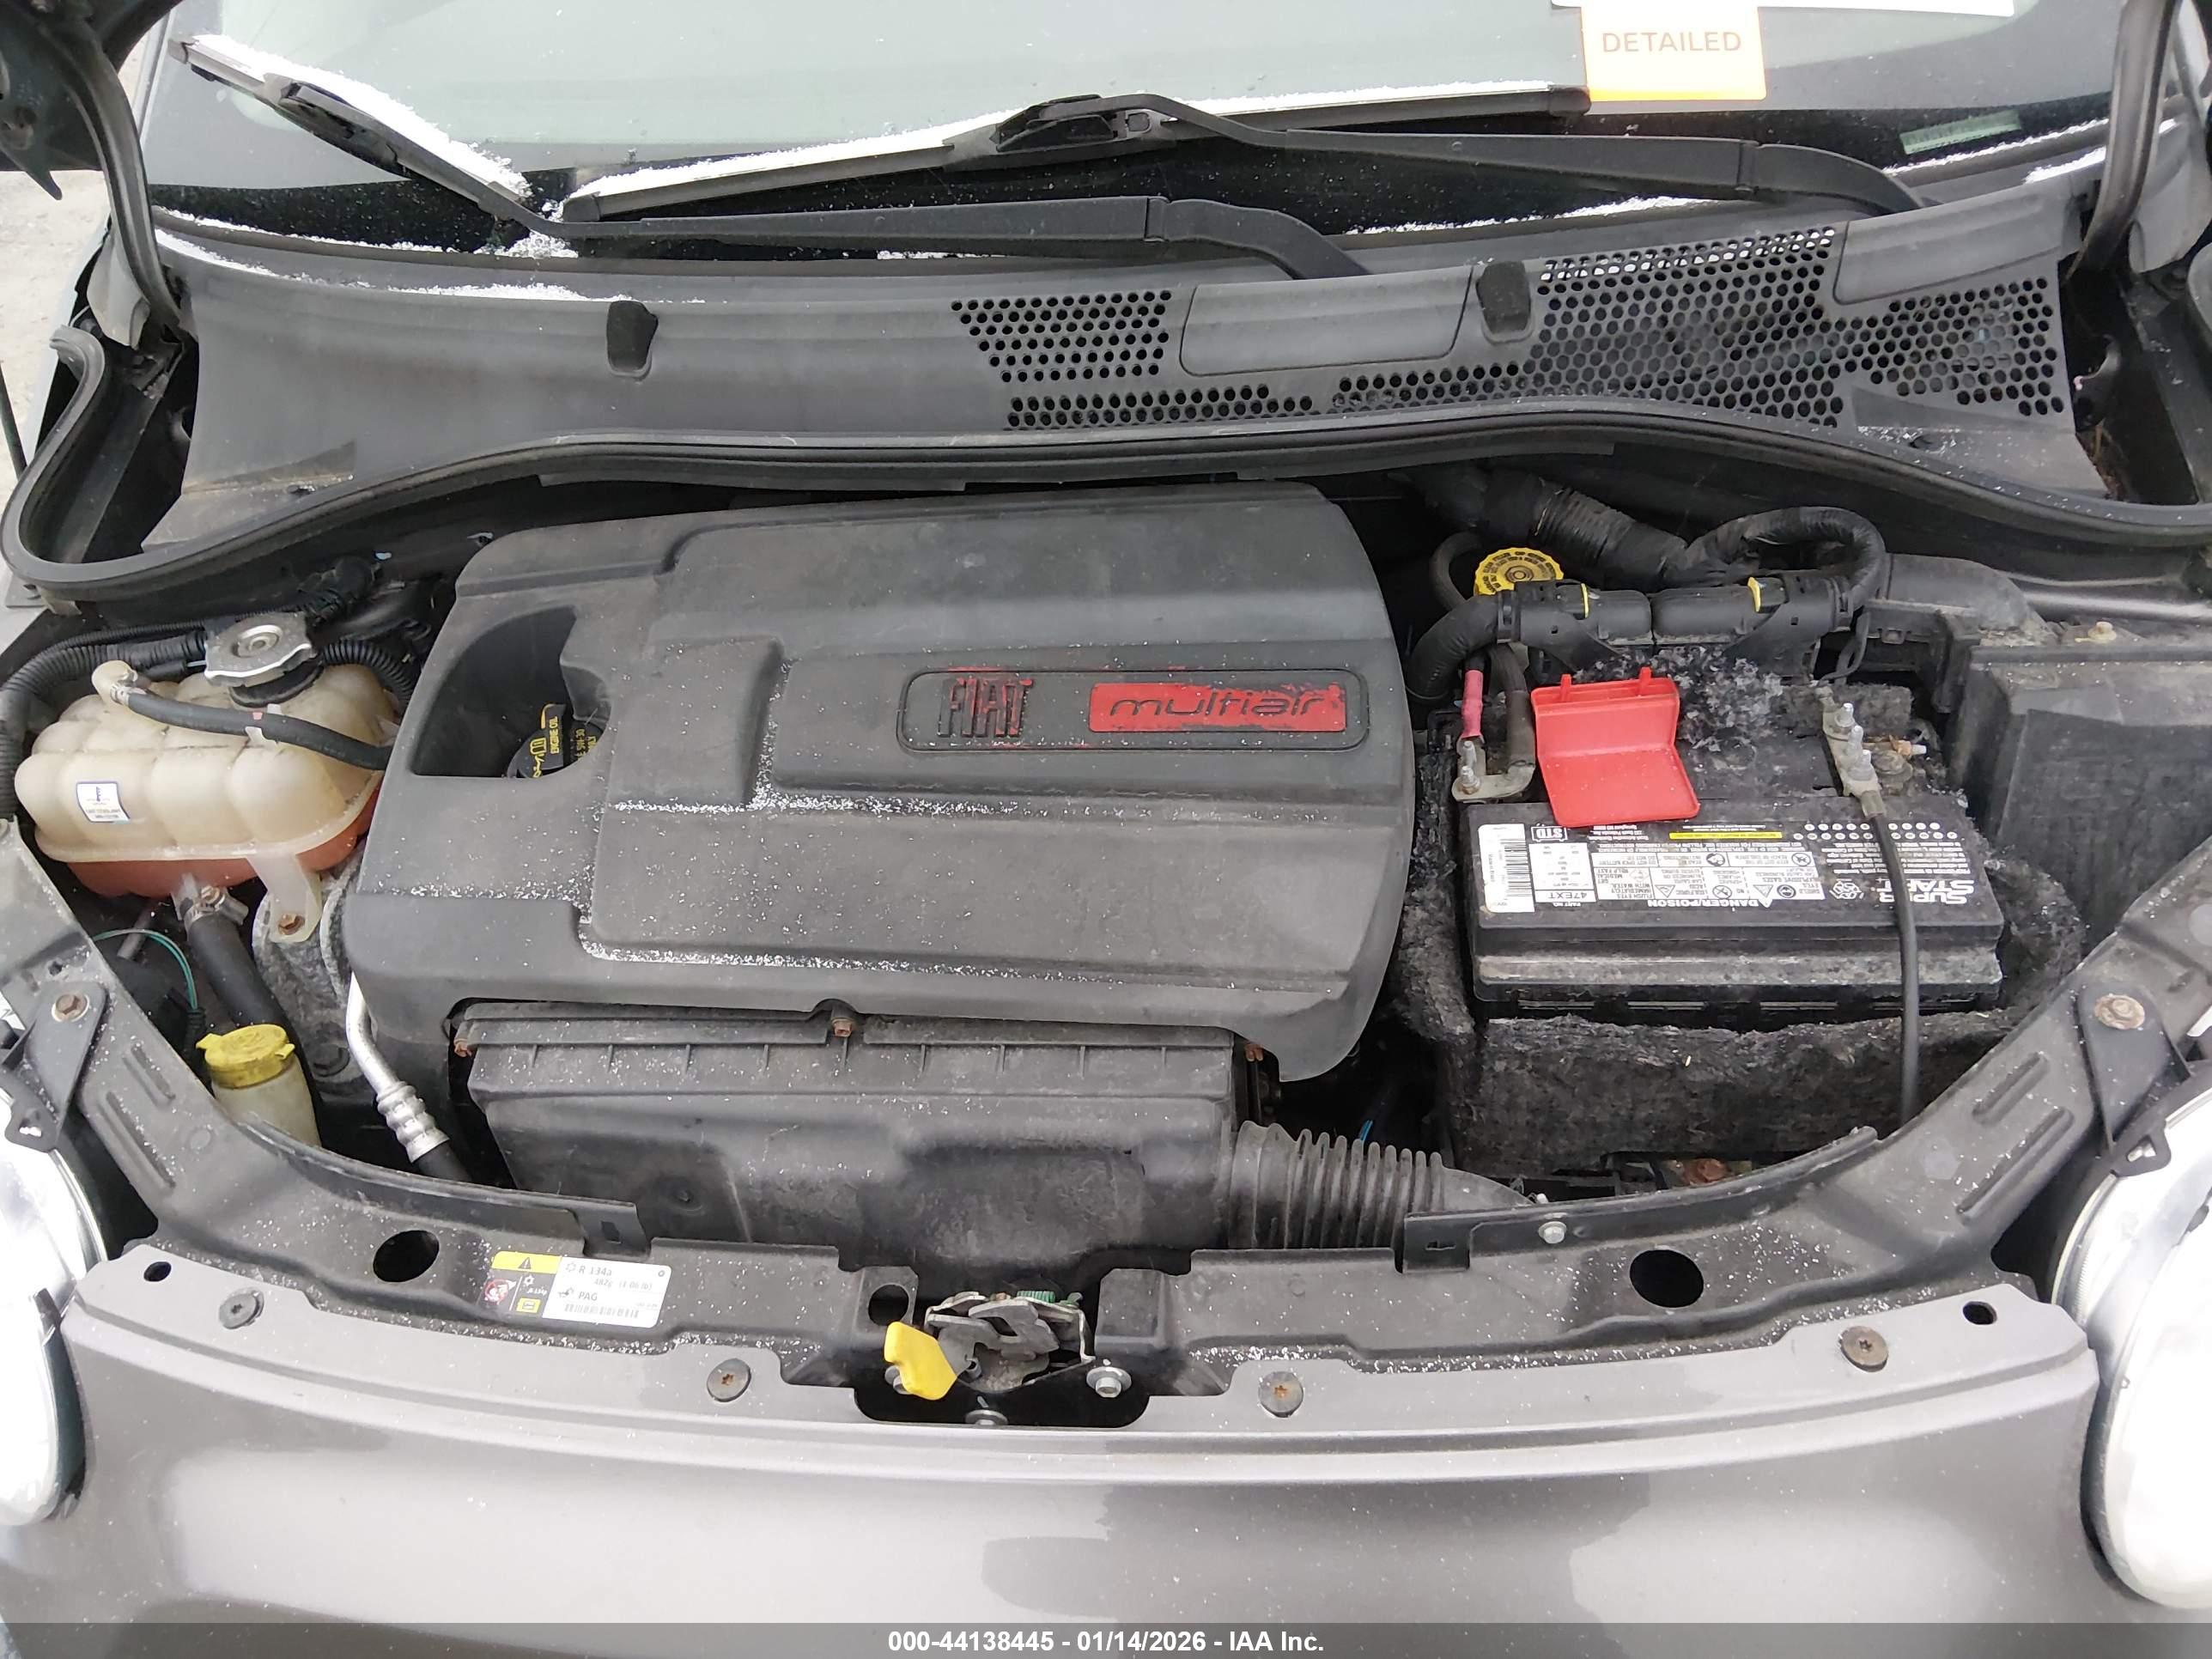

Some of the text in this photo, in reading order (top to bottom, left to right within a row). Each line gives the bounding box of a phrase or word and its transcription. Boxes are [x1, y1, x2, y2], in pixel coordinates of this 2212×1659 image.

[1602, 32, 1742, 52] DETAILED
[939, 677, 1324, 738] FIAT multiair
[1536, 828, 1564, 839] STD
[1879, 892, 1967, 904] SUPR
[579, 1266, 612, 1277] R 134a
[579, 1291, 599, 1301] PAG
